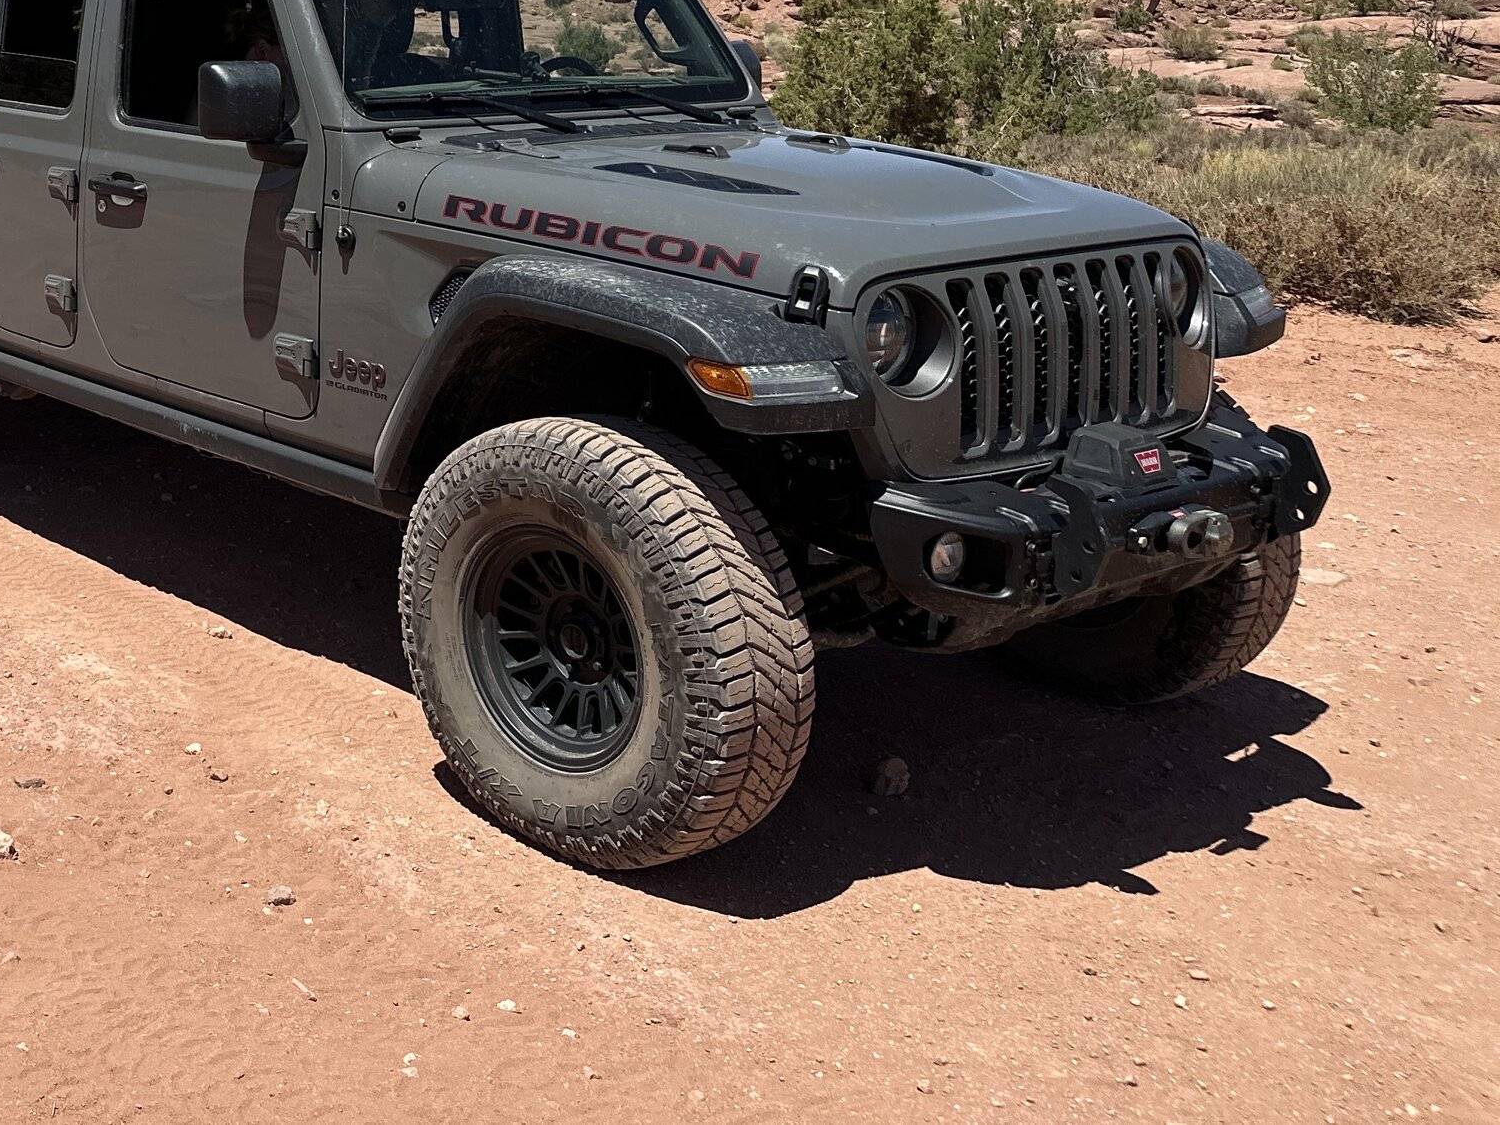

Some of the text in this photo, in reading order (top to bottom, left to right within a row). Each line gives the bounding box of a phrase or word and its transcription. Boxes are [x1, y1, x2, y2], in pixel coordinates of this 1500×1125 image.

[442, 193, 762, 280] RUBICON
[328, 348, 387, 392] Jeep
[334, 381, 389, 402] GLADIATOR
